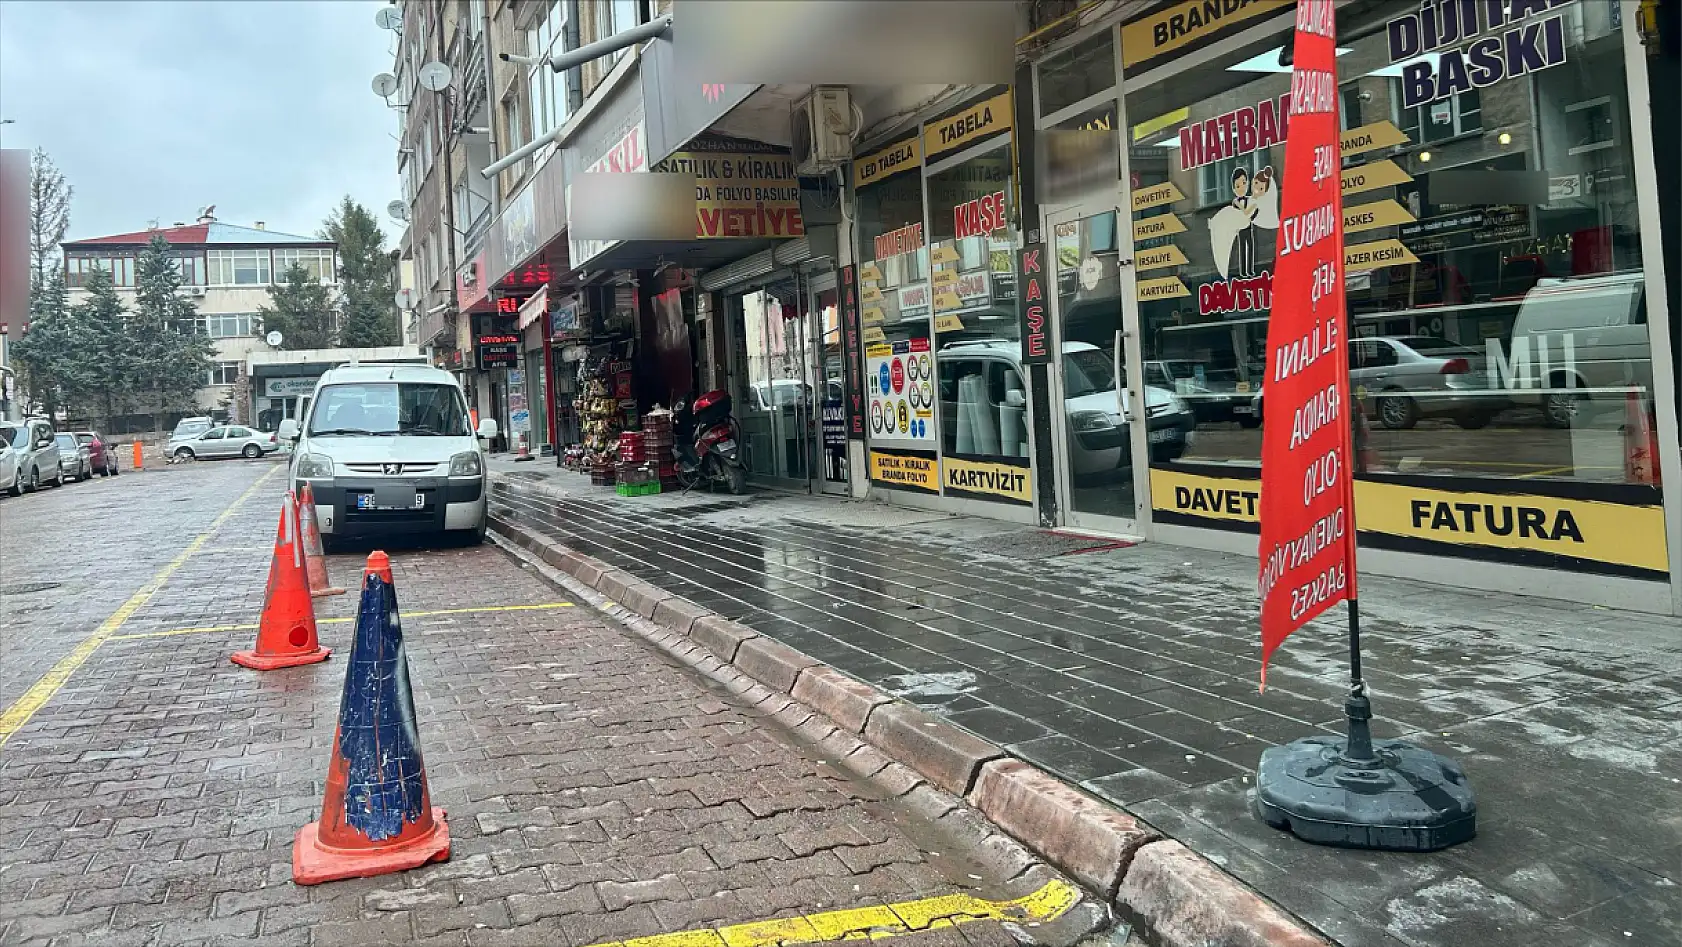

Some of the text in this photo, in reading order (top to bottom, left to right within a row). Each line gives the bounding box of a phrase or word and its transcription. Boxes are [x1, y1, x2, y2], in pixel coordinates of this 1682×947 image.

[1402, 13, 1567, 110] BASKI
[939, 107, 993, 144] TABELA
[860, 146, 914, 180] LED TABELA
[716, 187, 752, 201] FOLYO
[755, 187, 800, 202] BASILIR
[1134, 189, 1171, 206] DAVETİYE
[954, 191, 1005, 240] KAŞE
[1137, 222, 1165, 236] FATURA
[1138, 252, 1172, 267] İRSALİYE
[1373, 246, 1404, 262] KESİM
[1140, 282, 1180, 297] KARTVİZİT
[1199, 270, 1275, 315] DAVETİ
[1023, 249, 1046, 357] KAŞE
[878, 458, 900, 469] SATILIK
[906, 471, 928, 483] FOLYO
[950, 468, 1025, 492] KARTVİZİT
[1411, 500, 1584, 543] FATURA
